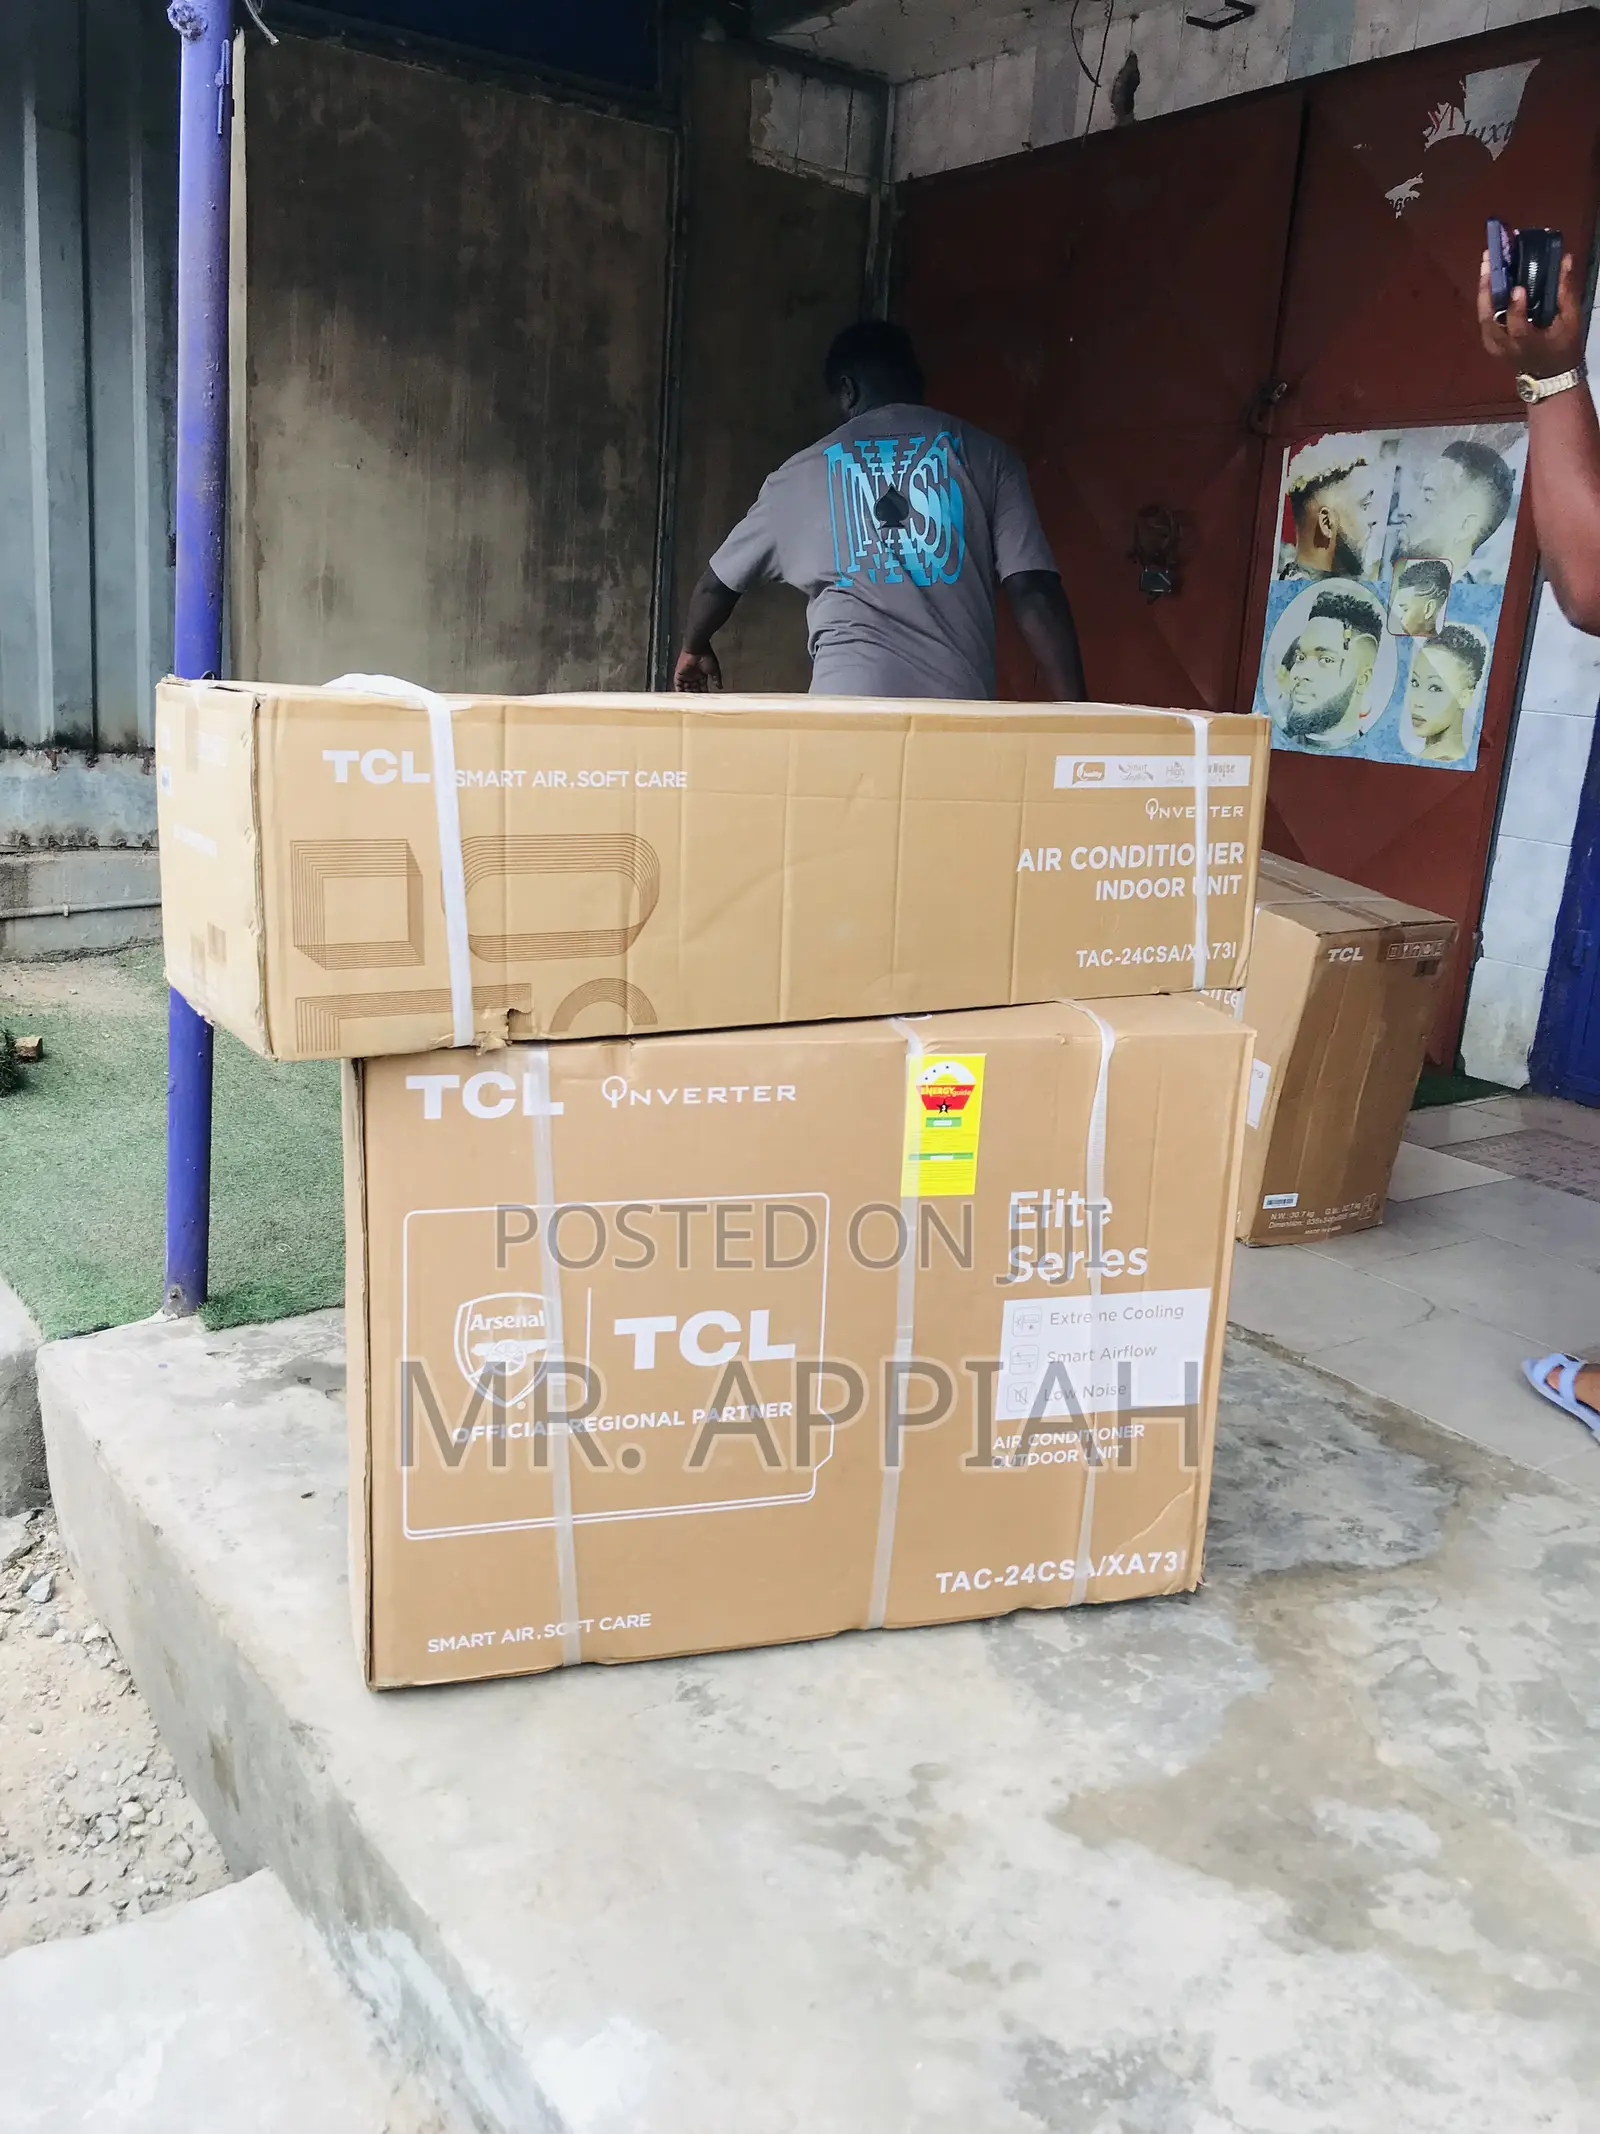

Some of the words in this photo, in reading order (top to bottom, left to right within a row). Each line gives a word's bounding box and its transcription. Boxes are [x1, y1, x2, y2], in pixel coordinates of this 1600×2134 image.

[322, 749, 430, 784] TCL
[455, 769, 526, 788] SMART
[578, 769, 629, 788] SOFT
[635, 769, 688, 788] CARE
[1145, 797, 1245, 820] INVETER
[1017, 847, 1062, 872] AIR
[1070, 842, 1246, 872] CONDITIOER
[1096, 877, 1186, 901] INDOOR
[1327, 947, 1364, 963] TCL
[405, 1070, 564, 1119] TCL
[1009, 1245, 1148, 1283] Seres
[469, 1310, 545, 1331] Arsenal
[1123, 1304, 1184, 1320] Cooling
[613, 1309, 796, 1370] TCL
[1047, 1349, 1095, 1364] Smart
[1100, 1344, 1157, 1361] Airflow
[1043, 1388, 1077, 1402] Low
[1083, 1384, 1127, 1398] Noise
[568, 1411, 685, 1434] REGIONAL
[692, 1401, 793, 1425] PARTNER
[992, 1435, 1022, 1450] AIR
[992, 1449, 1078, 1468] OUTDOOR
[428, 1631, 497, 1653] SMART
[544, 1618, 594, 1638] SOT
[599, 1613, 652, 1631] CARE
